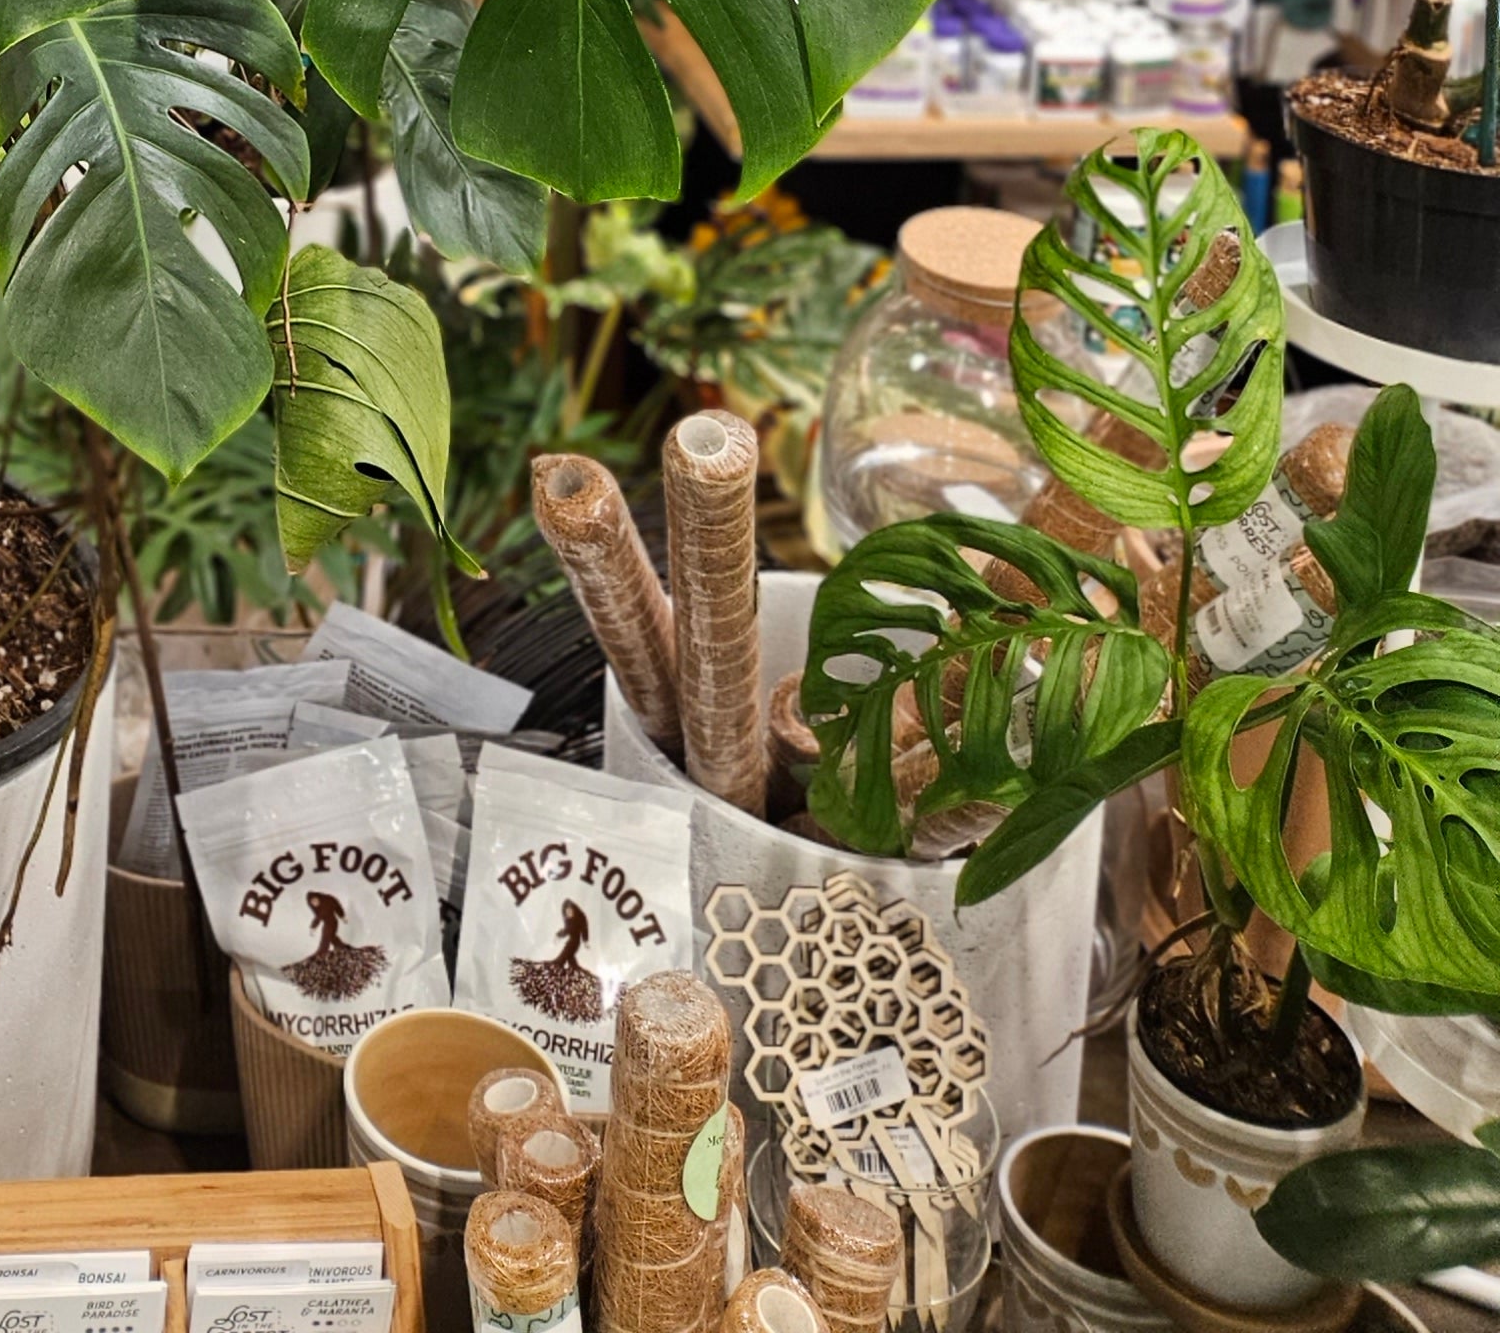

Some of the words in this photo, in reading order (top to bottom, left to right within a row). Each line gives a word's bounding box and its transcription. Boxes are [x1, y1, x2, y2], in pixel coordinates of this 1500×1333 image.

[239, 851, 304, 927] BIG
[310, 842, 413, 907] FOOT
[497, 842, 573, 907] BIG
[580, 847, 667, 946] FOOT
[268, 1004, 414, 1037] MYCORRHI
[205, 1266, 286, 1277] CARNIVOROUS
[308, 1265, 373, 1277] NIVOROUS
[78, 1273, 127, 1284] BONSAI
[86, 1301, 114, 1310] BIRD
[120, 1299, 138, 1309] OF
[308, 1299, 371, 1308] CALATHEA
[81, 1309, 140, 1319] PARADISE
[318, 1307, 374, 1315] MARANTA
